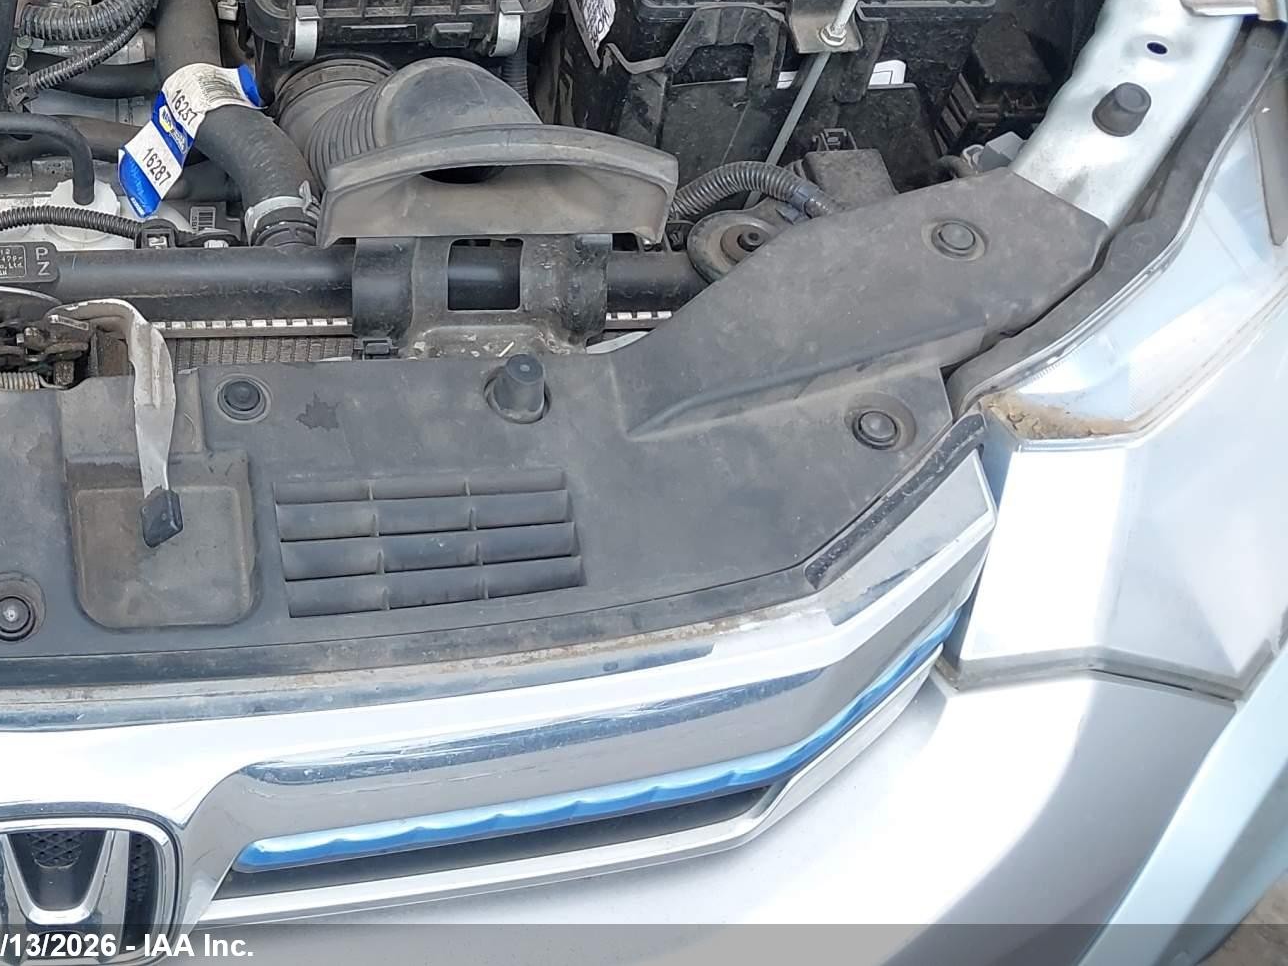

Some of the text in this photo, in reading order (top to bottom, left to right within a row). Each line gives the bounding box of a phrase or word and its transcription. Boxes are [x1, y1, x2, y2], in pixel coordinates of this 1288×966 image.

[142, 147, 172, 186] 16287
[35, 247, 49, 260] P
[37, 261, 50, 275] Z
